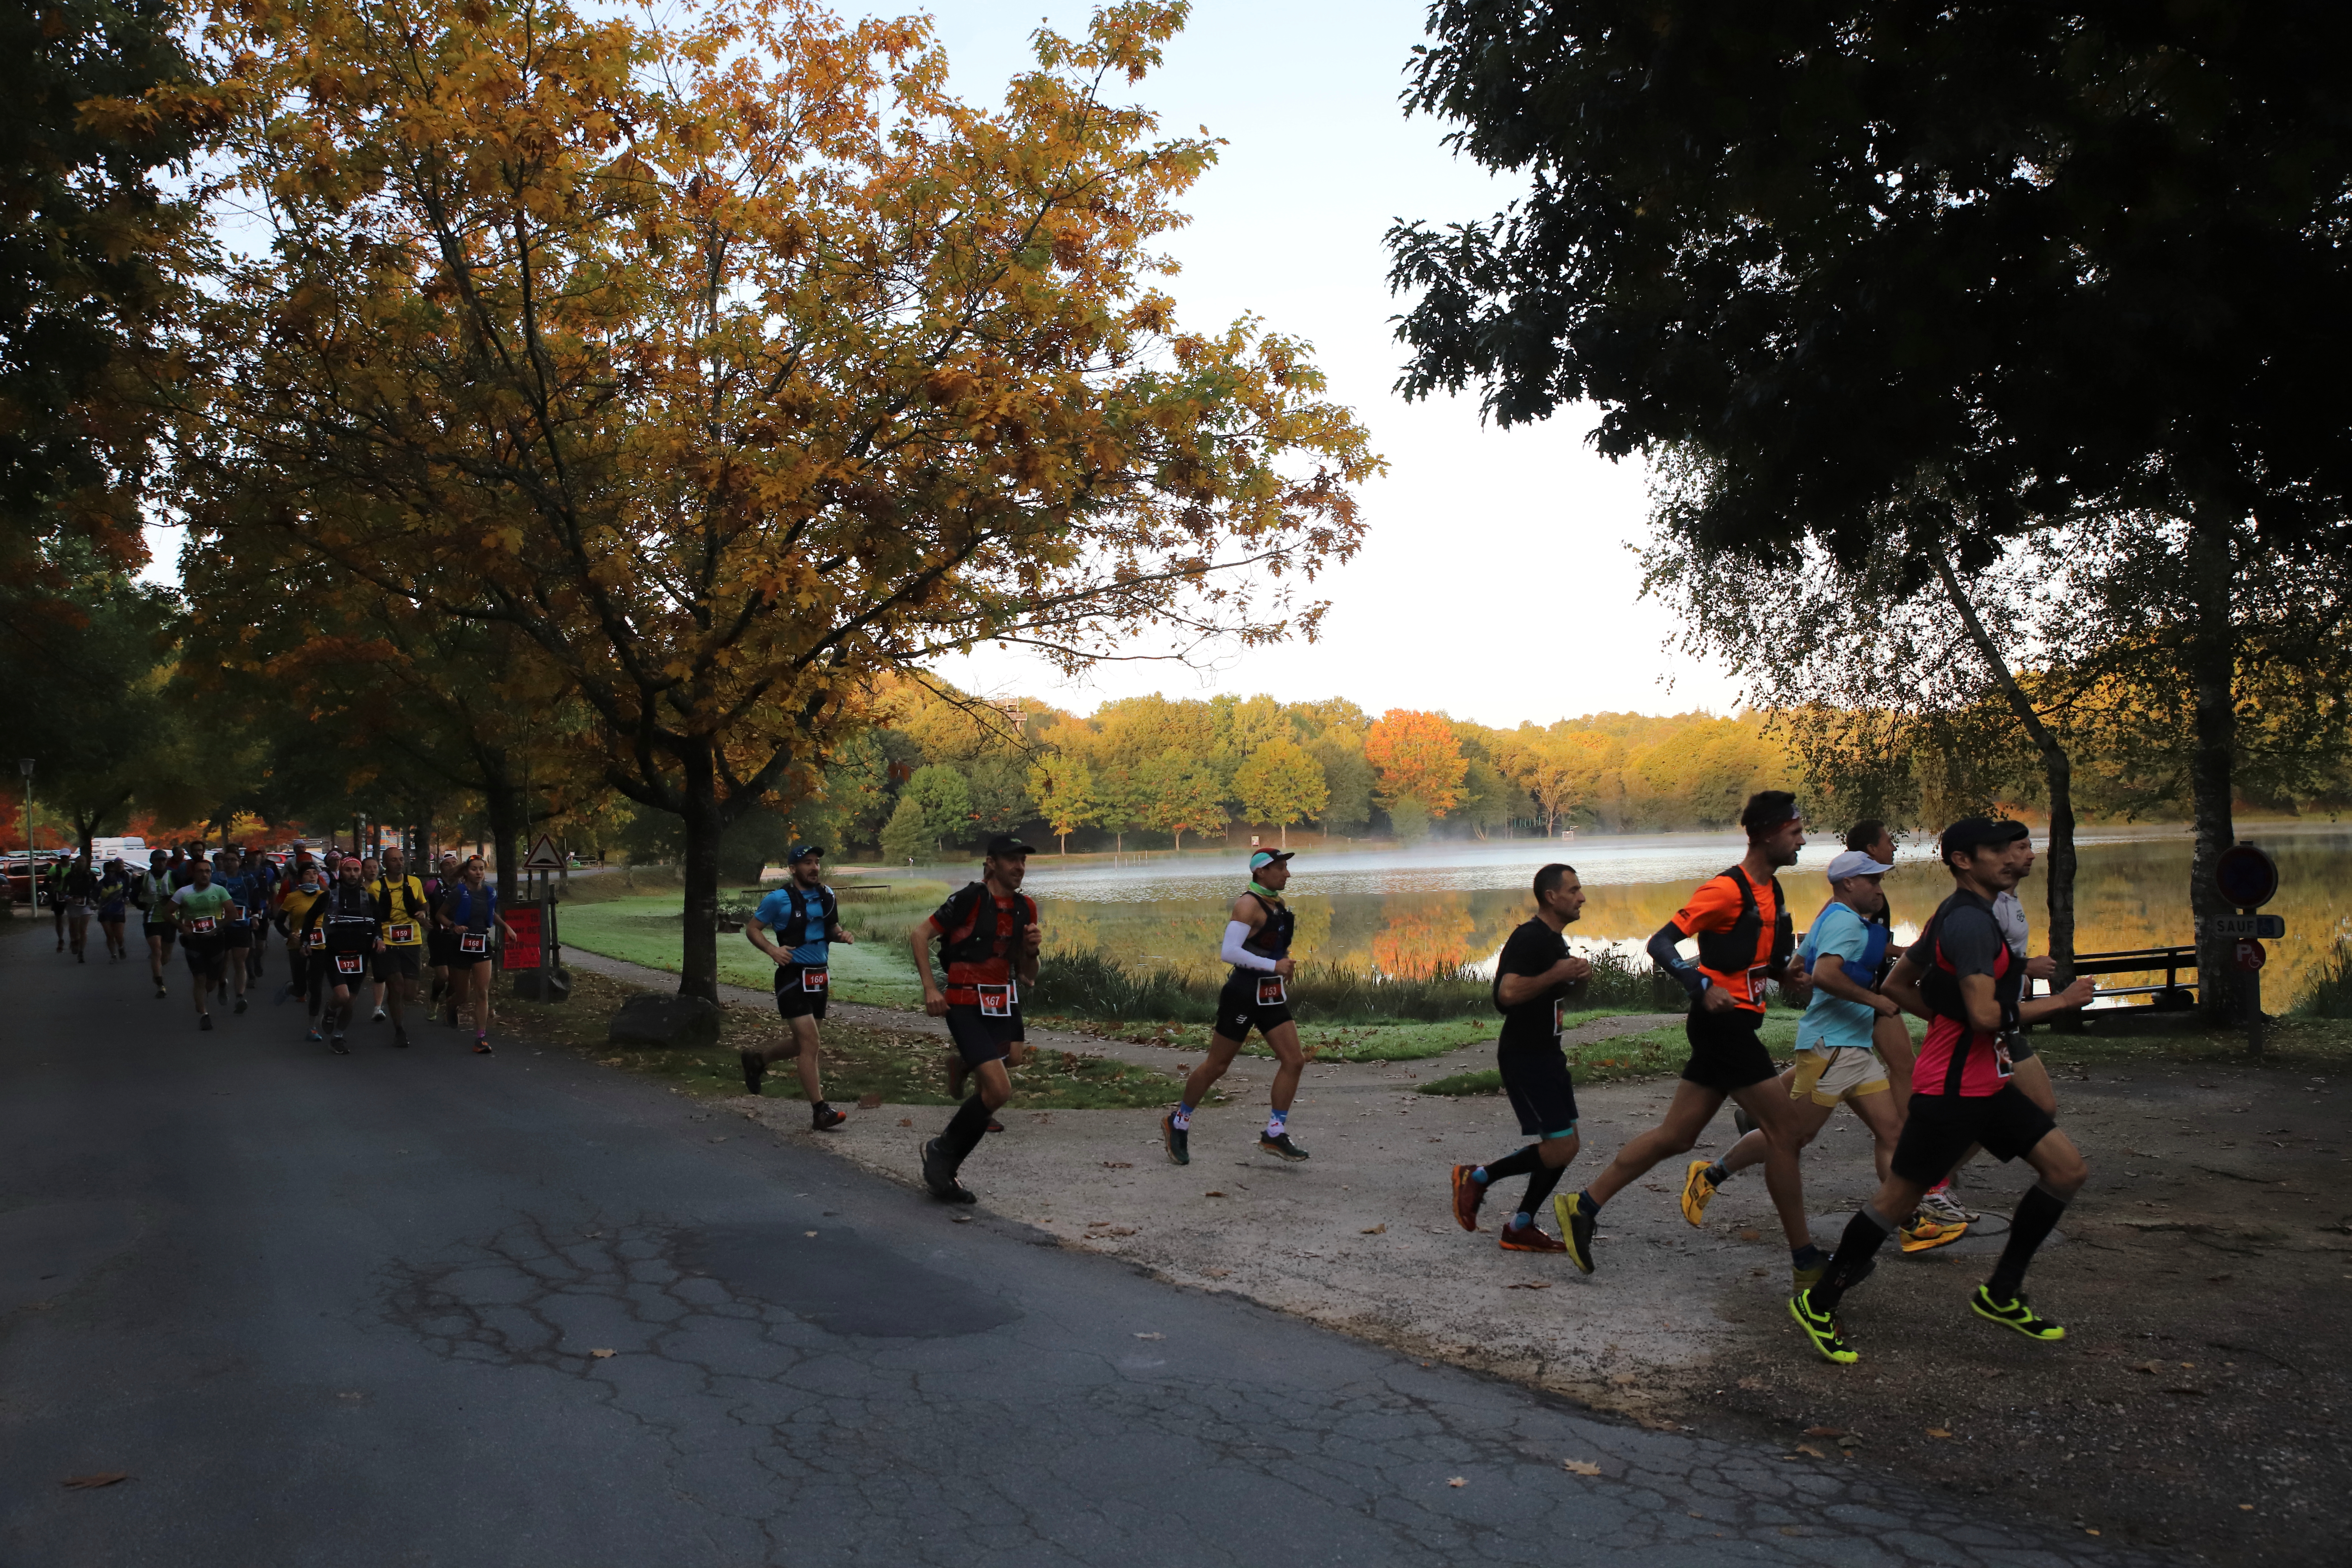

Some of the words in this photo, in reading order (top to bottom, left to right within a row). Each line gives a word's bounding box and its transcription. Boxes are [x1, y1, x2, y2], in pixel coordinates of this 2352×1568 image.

[2217, 920, 2254, 932] SAUF
[2237, 944, 2252, 961] P
[810, 975, 823, 983] 160
[1264, 986, 1277, 995] 153
[985, 996, 1000, 1006] 167
